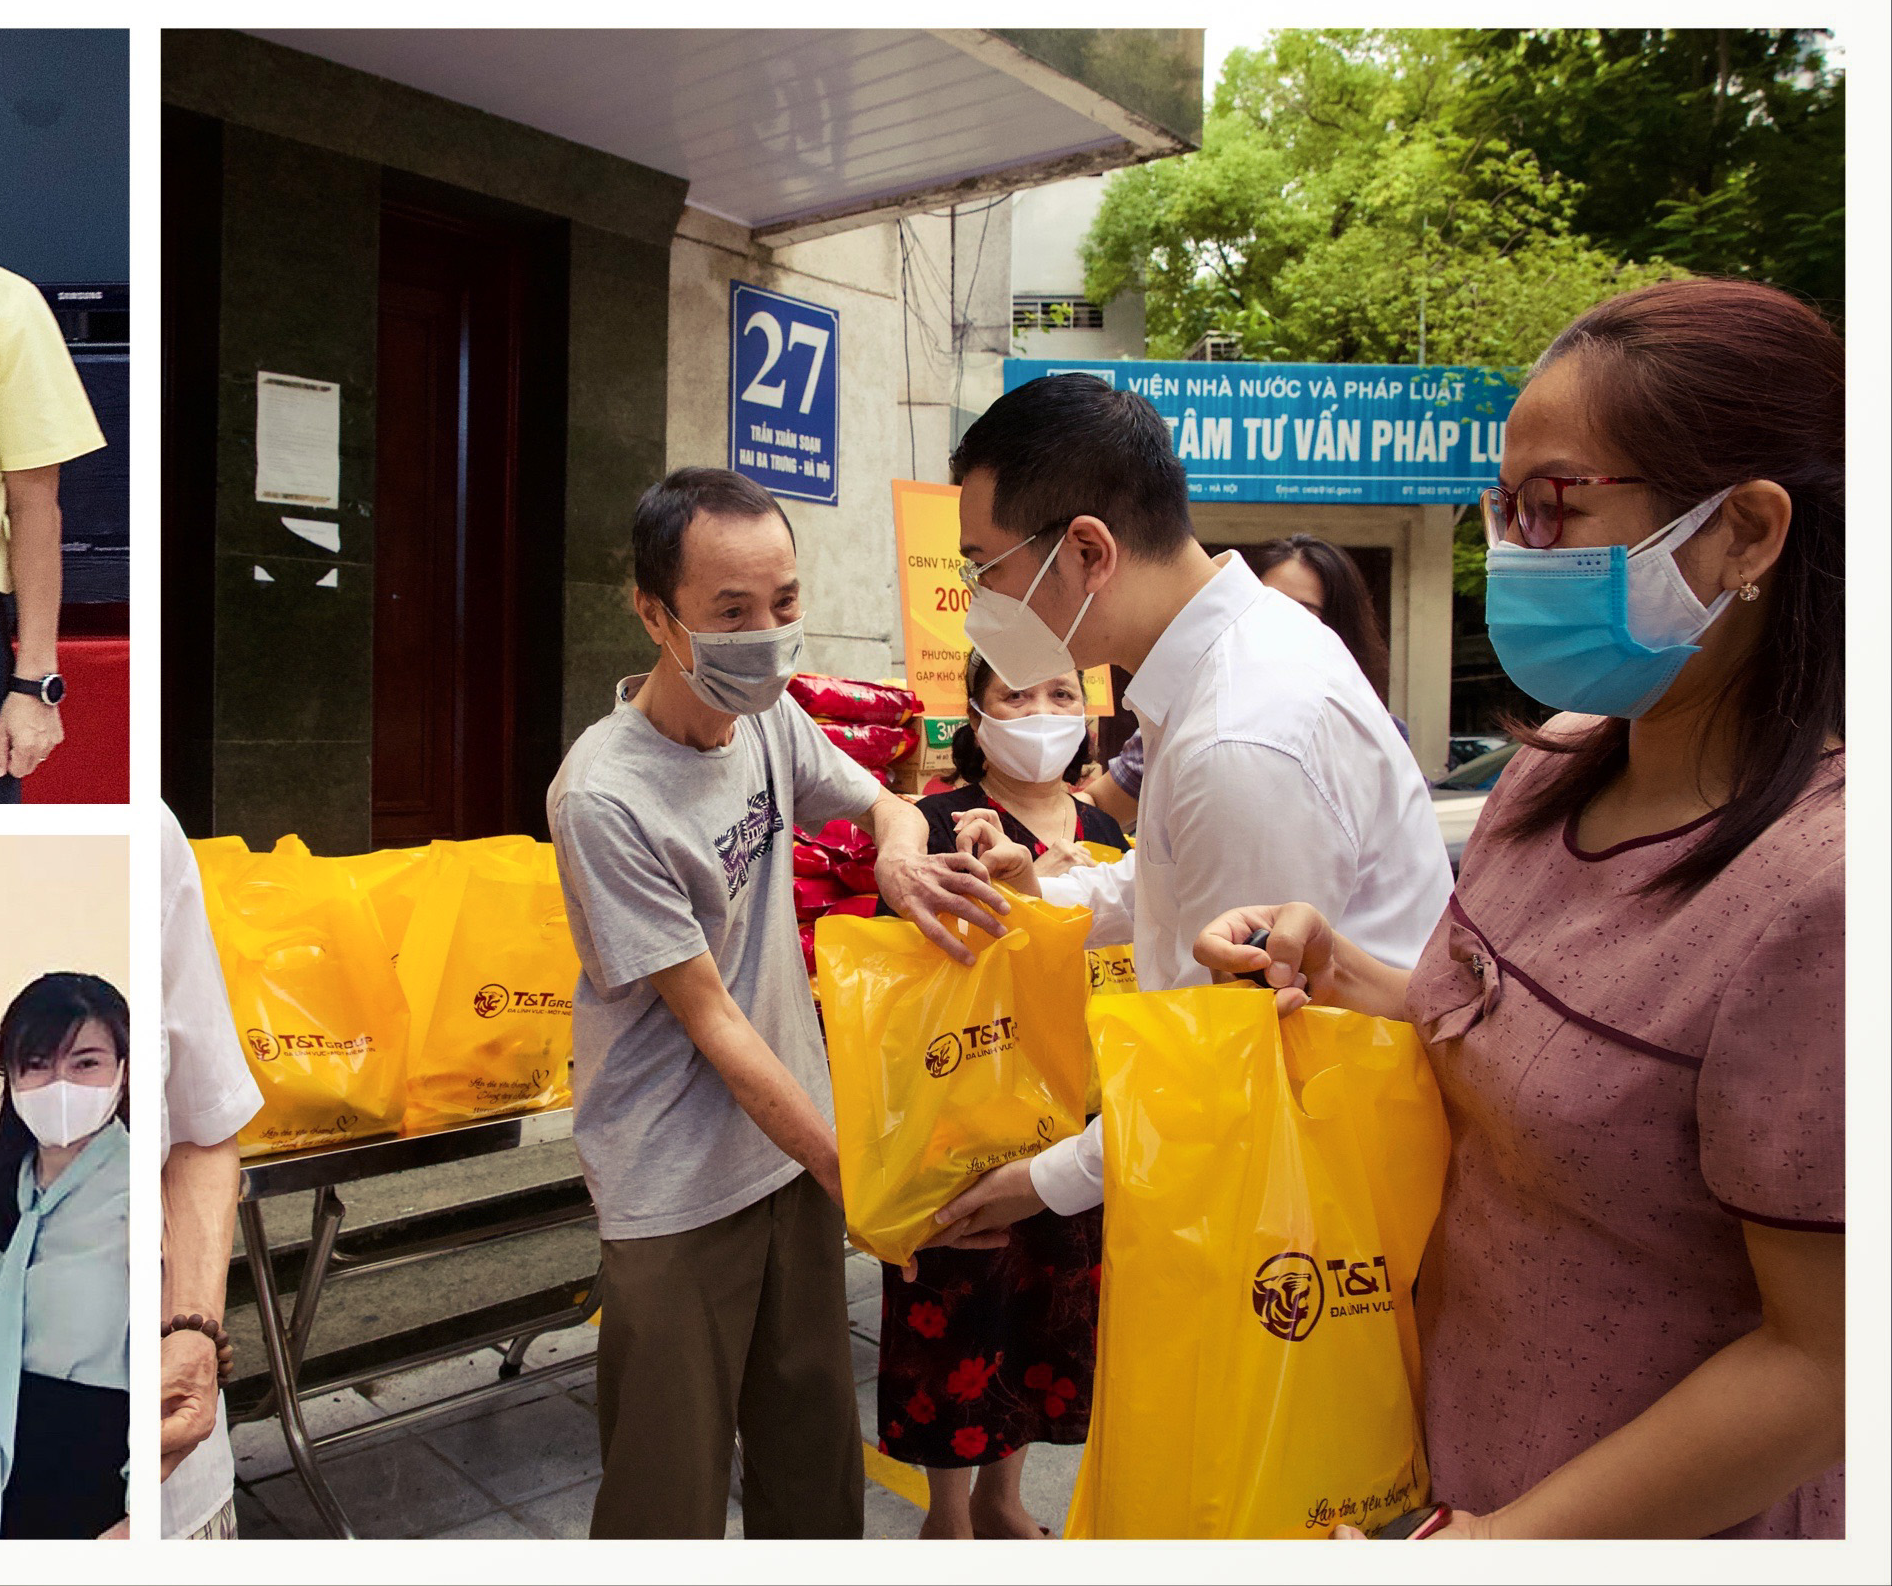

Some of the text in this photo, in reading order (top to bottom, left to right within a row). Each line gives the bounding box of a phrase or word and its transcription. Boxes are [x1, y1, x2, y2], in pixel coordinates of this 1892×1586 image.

[741, 311, 830, 415] 27
[1128, 373, 1179, 399] VIỆN
[1187, 374, 1232, 397] NHÀ
[1240, 375, 1301, 399] NƯỚC
[1309, 376, 1337, 399] VÀ
[1344, 377, 1403, 400] PHÁP
[1243, 413, 1288, 461] TƯ
[1294, 403, 1361, 462] VẤN
[1371, 411, 1460, 463] PHÁP
[740, 448, 754, 466] HAI
[908, 555, 938, 569] CBNV
[935, 586, 971, 612] 200
[922, 648, 962, 661] PHƯỜNG
[1330, 1306, 1347, 1317] ĐA
[1306, 1498, 1336, 1529] Lan
